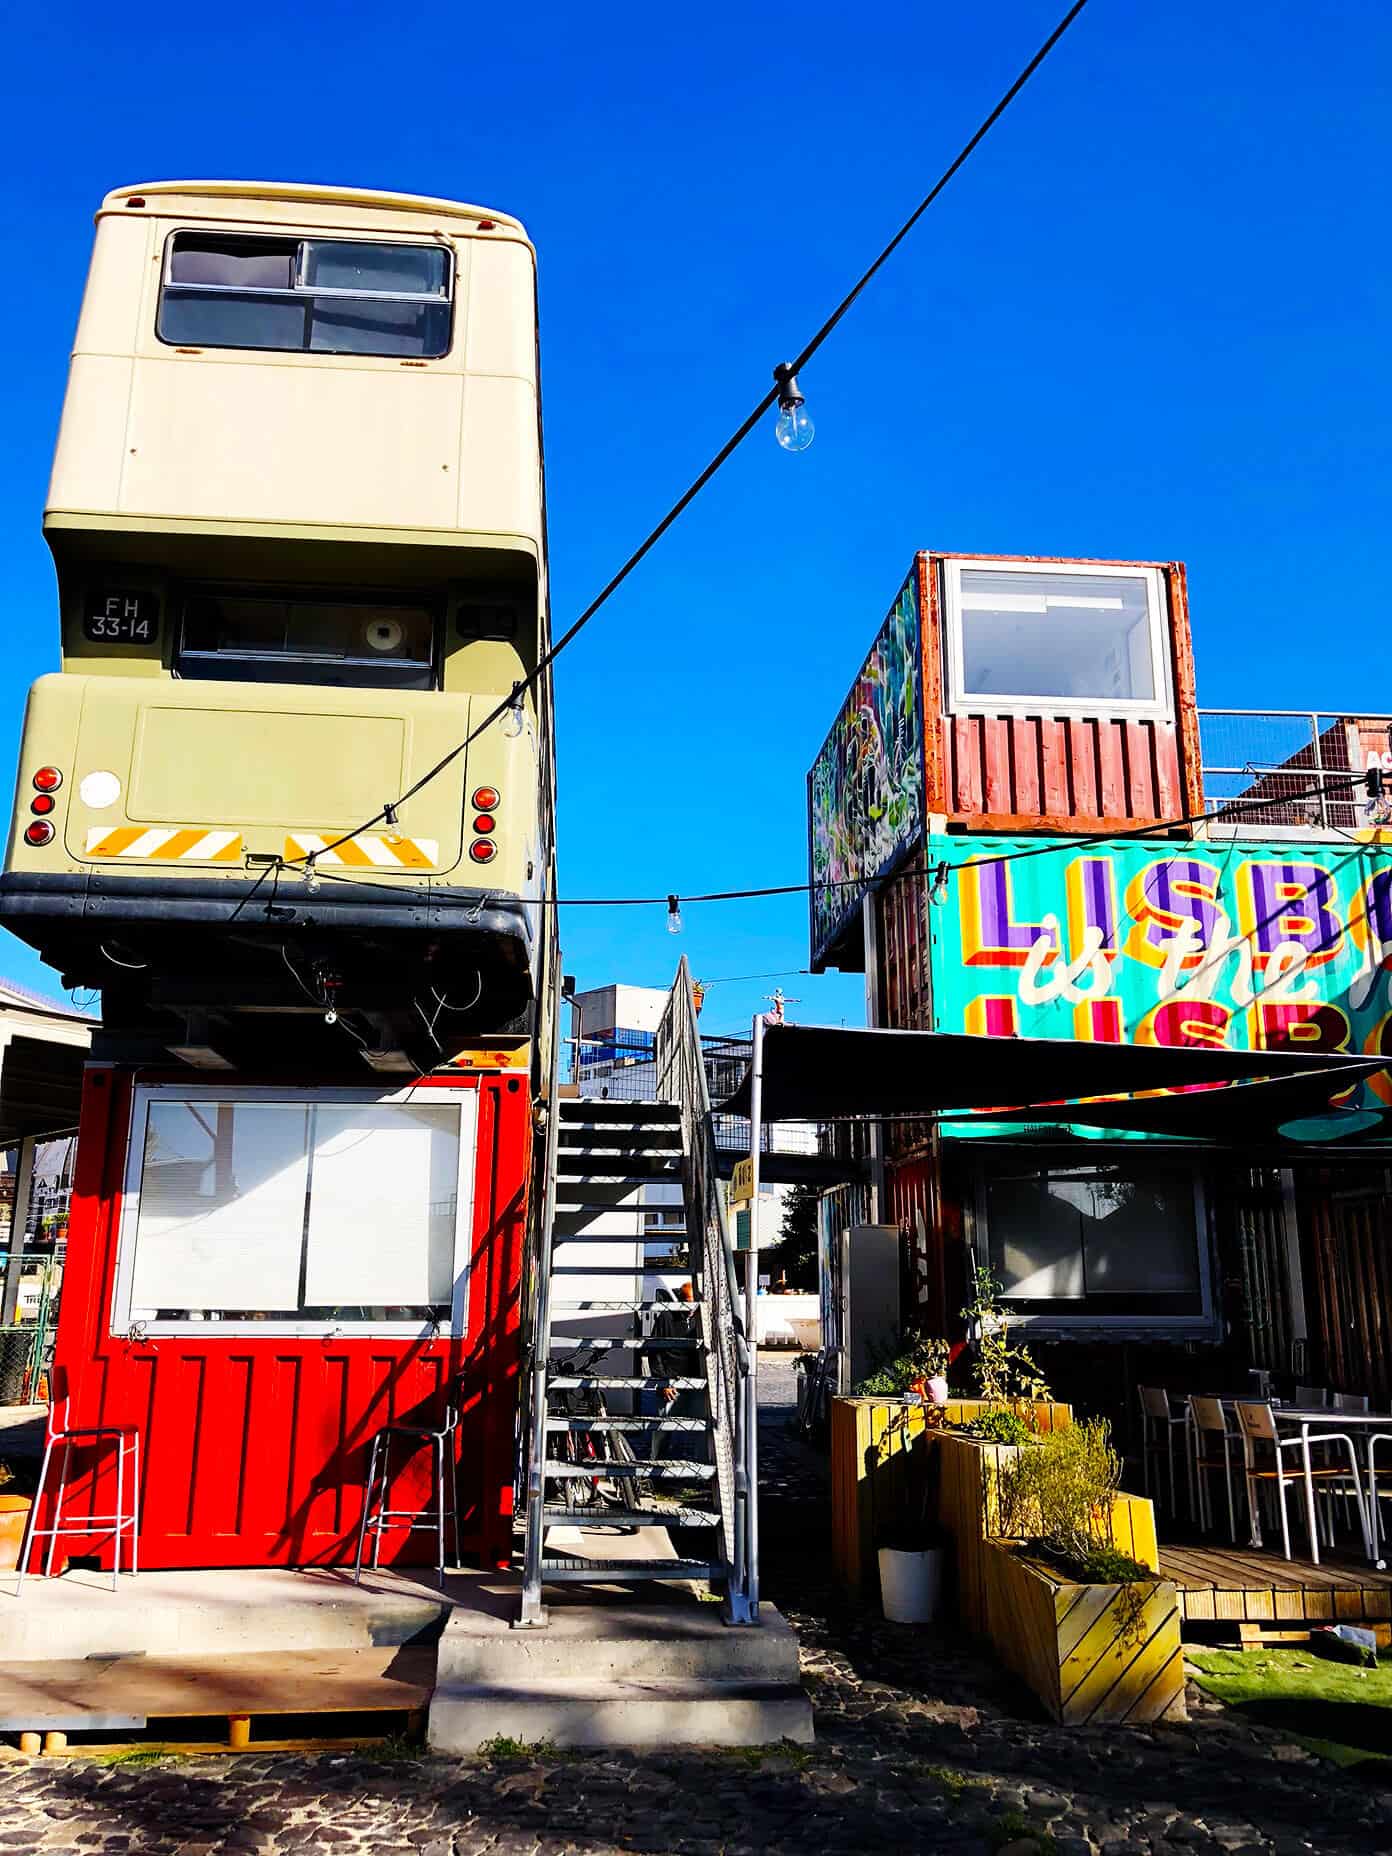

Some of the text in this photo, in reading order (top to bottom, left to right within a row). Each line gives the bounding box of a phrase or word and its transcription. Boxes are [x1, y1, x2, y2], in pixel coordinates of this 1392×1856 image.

[105, 598, 138, 617] FH
[91, 616, 150, 638] 33-14
[1018, 912, 1113, 1006] is
[1157, 916, 1318, 1007] the
